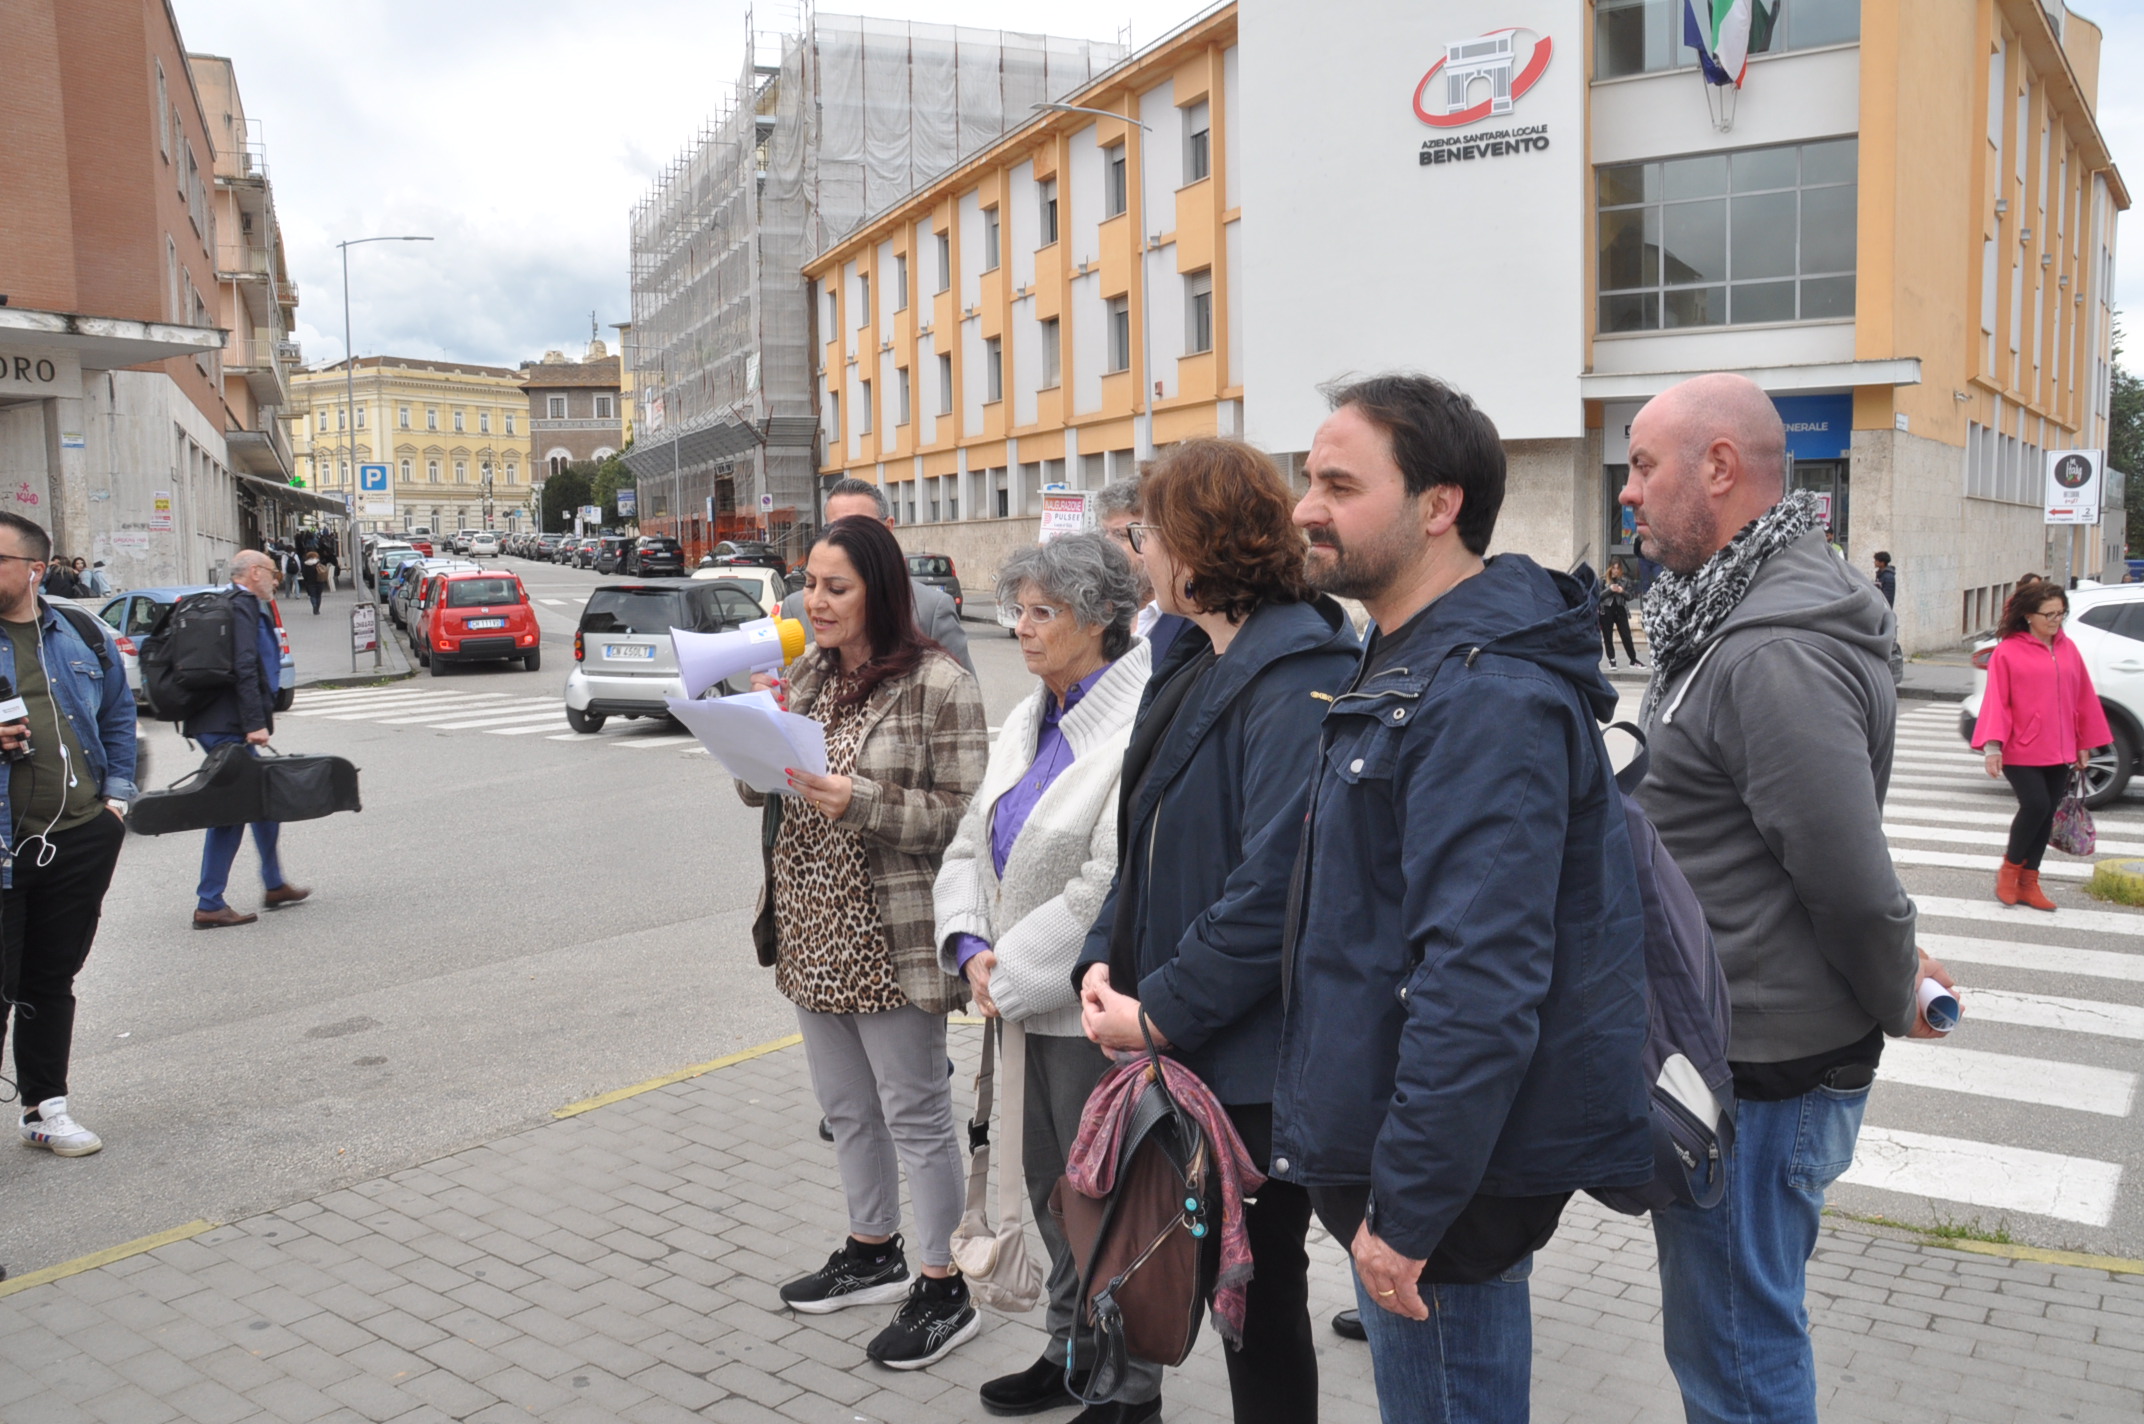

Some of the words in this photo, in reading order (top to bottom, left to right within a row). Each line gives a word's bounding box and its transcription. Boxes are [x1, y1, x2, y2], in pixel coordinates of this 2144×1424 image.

[1421, 136, 1462, 149] AZIENDA
[1462, 129, 1511, 144] SANITARIA
[1511, 124, 1548, 137] LOCALE
[1419, 136, 1550, 166] BENEVENTO
[2066, 461, 2082, 481] Italy
[2070, 457, 2076, 465] in
[366, 468, 382, 488] P
[1054, 513, 1080, 521] PULSEE
